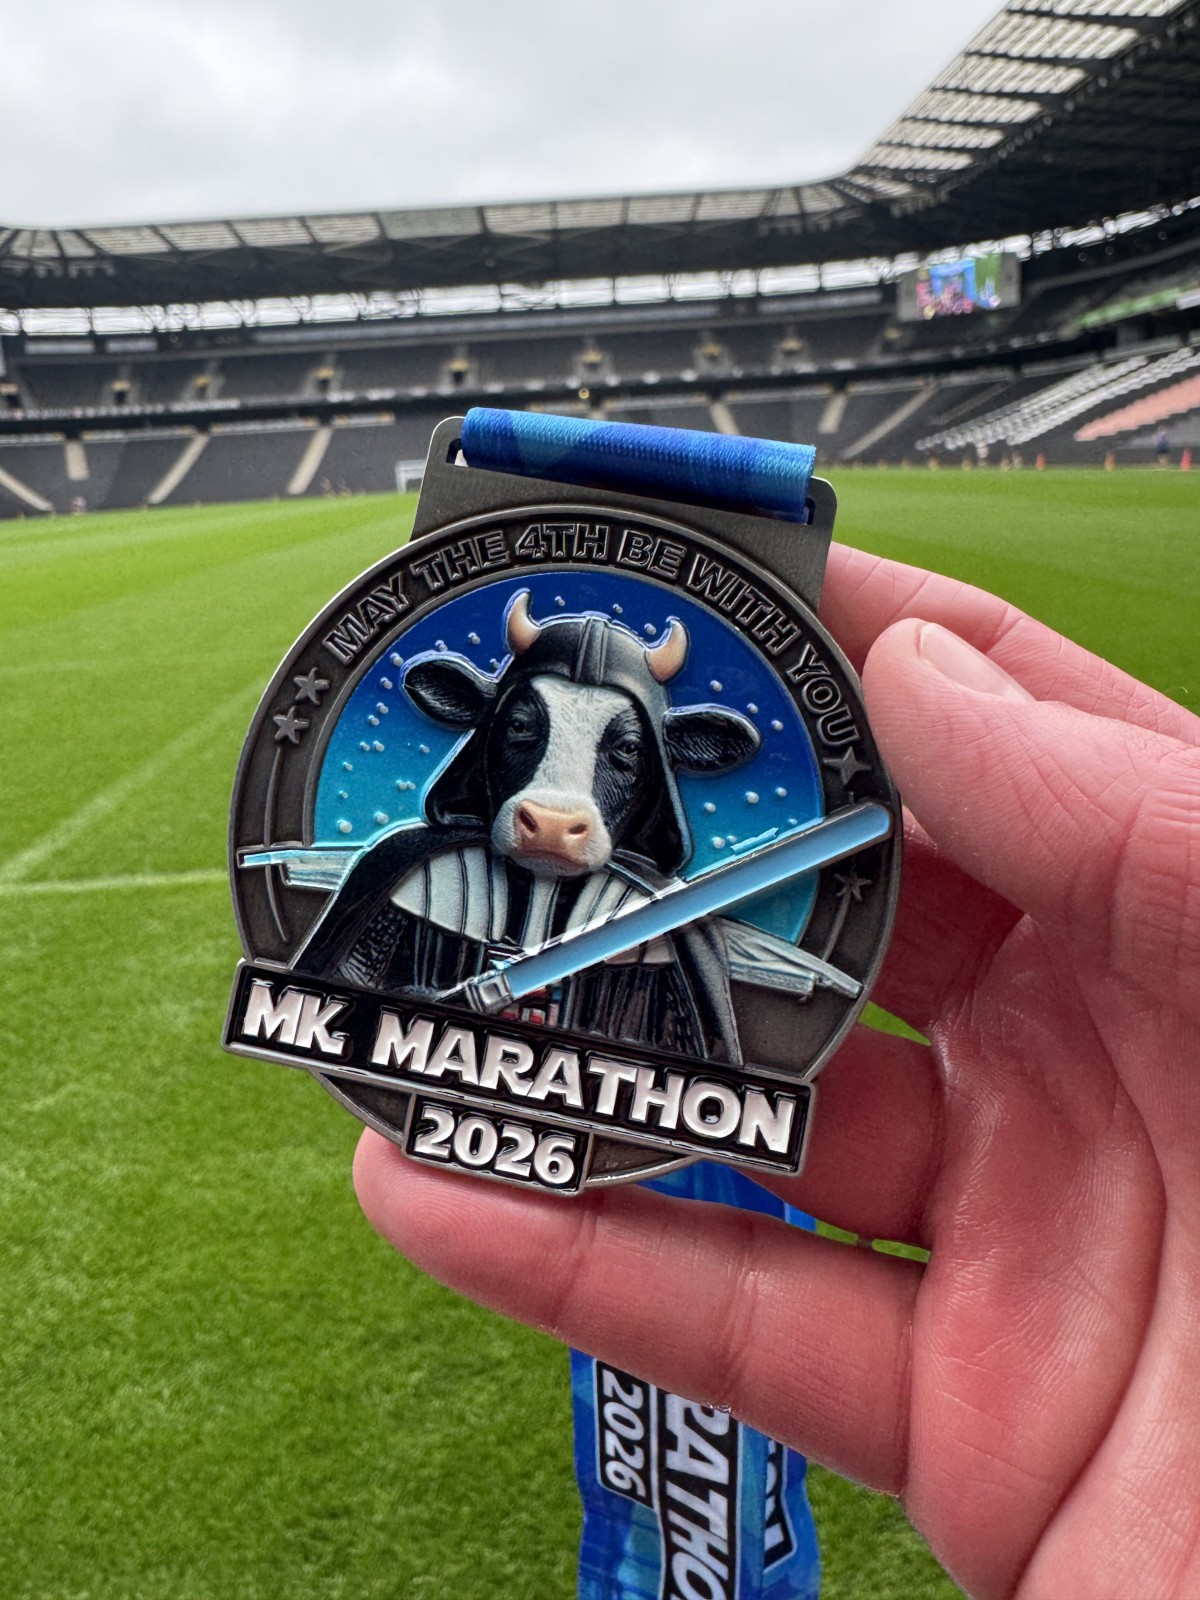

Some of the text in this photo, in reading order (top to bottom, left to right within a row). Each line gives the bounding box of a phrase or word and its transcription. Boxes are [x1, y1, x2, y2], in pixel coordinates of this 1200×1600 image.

[322, 523, 861, 748] MAY THE 4TH BE WITH YOU
[241, 982, 797, 1155] MK MARATHON
[413, 1107, 576, 1185] 2026
[602, 1369, 647, 1498] 2026
